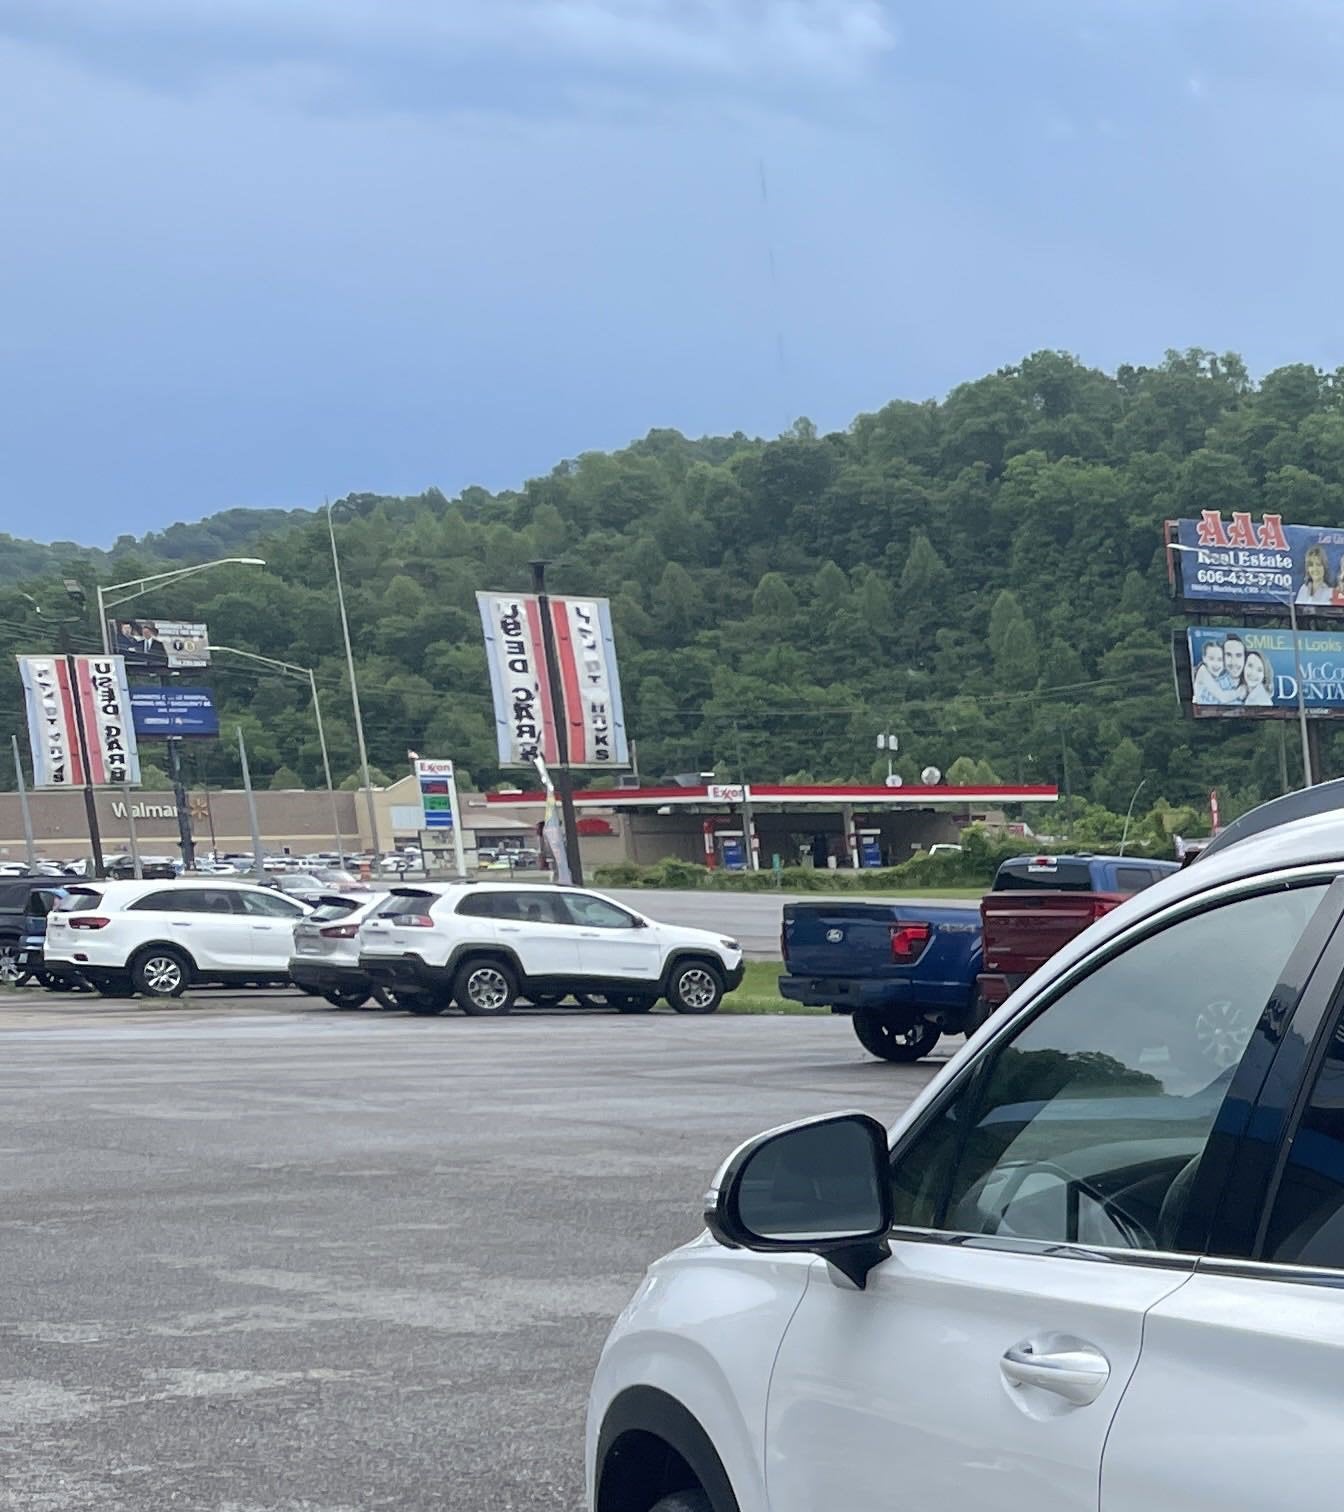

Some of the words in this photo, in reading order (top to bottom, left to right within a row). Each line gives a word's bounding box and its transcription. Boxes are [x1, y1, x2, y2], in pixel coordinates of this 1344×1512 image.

[1196, 509, 1290, 551] AAA
[1198, 549, 1236, 566] Real
[1239, 551, 1293, 569] Estate
[1306, 641, 1342, 652] Looks
[420, 762, 451, 774] Exxon
[111, 801, 178, 818] Walmar
